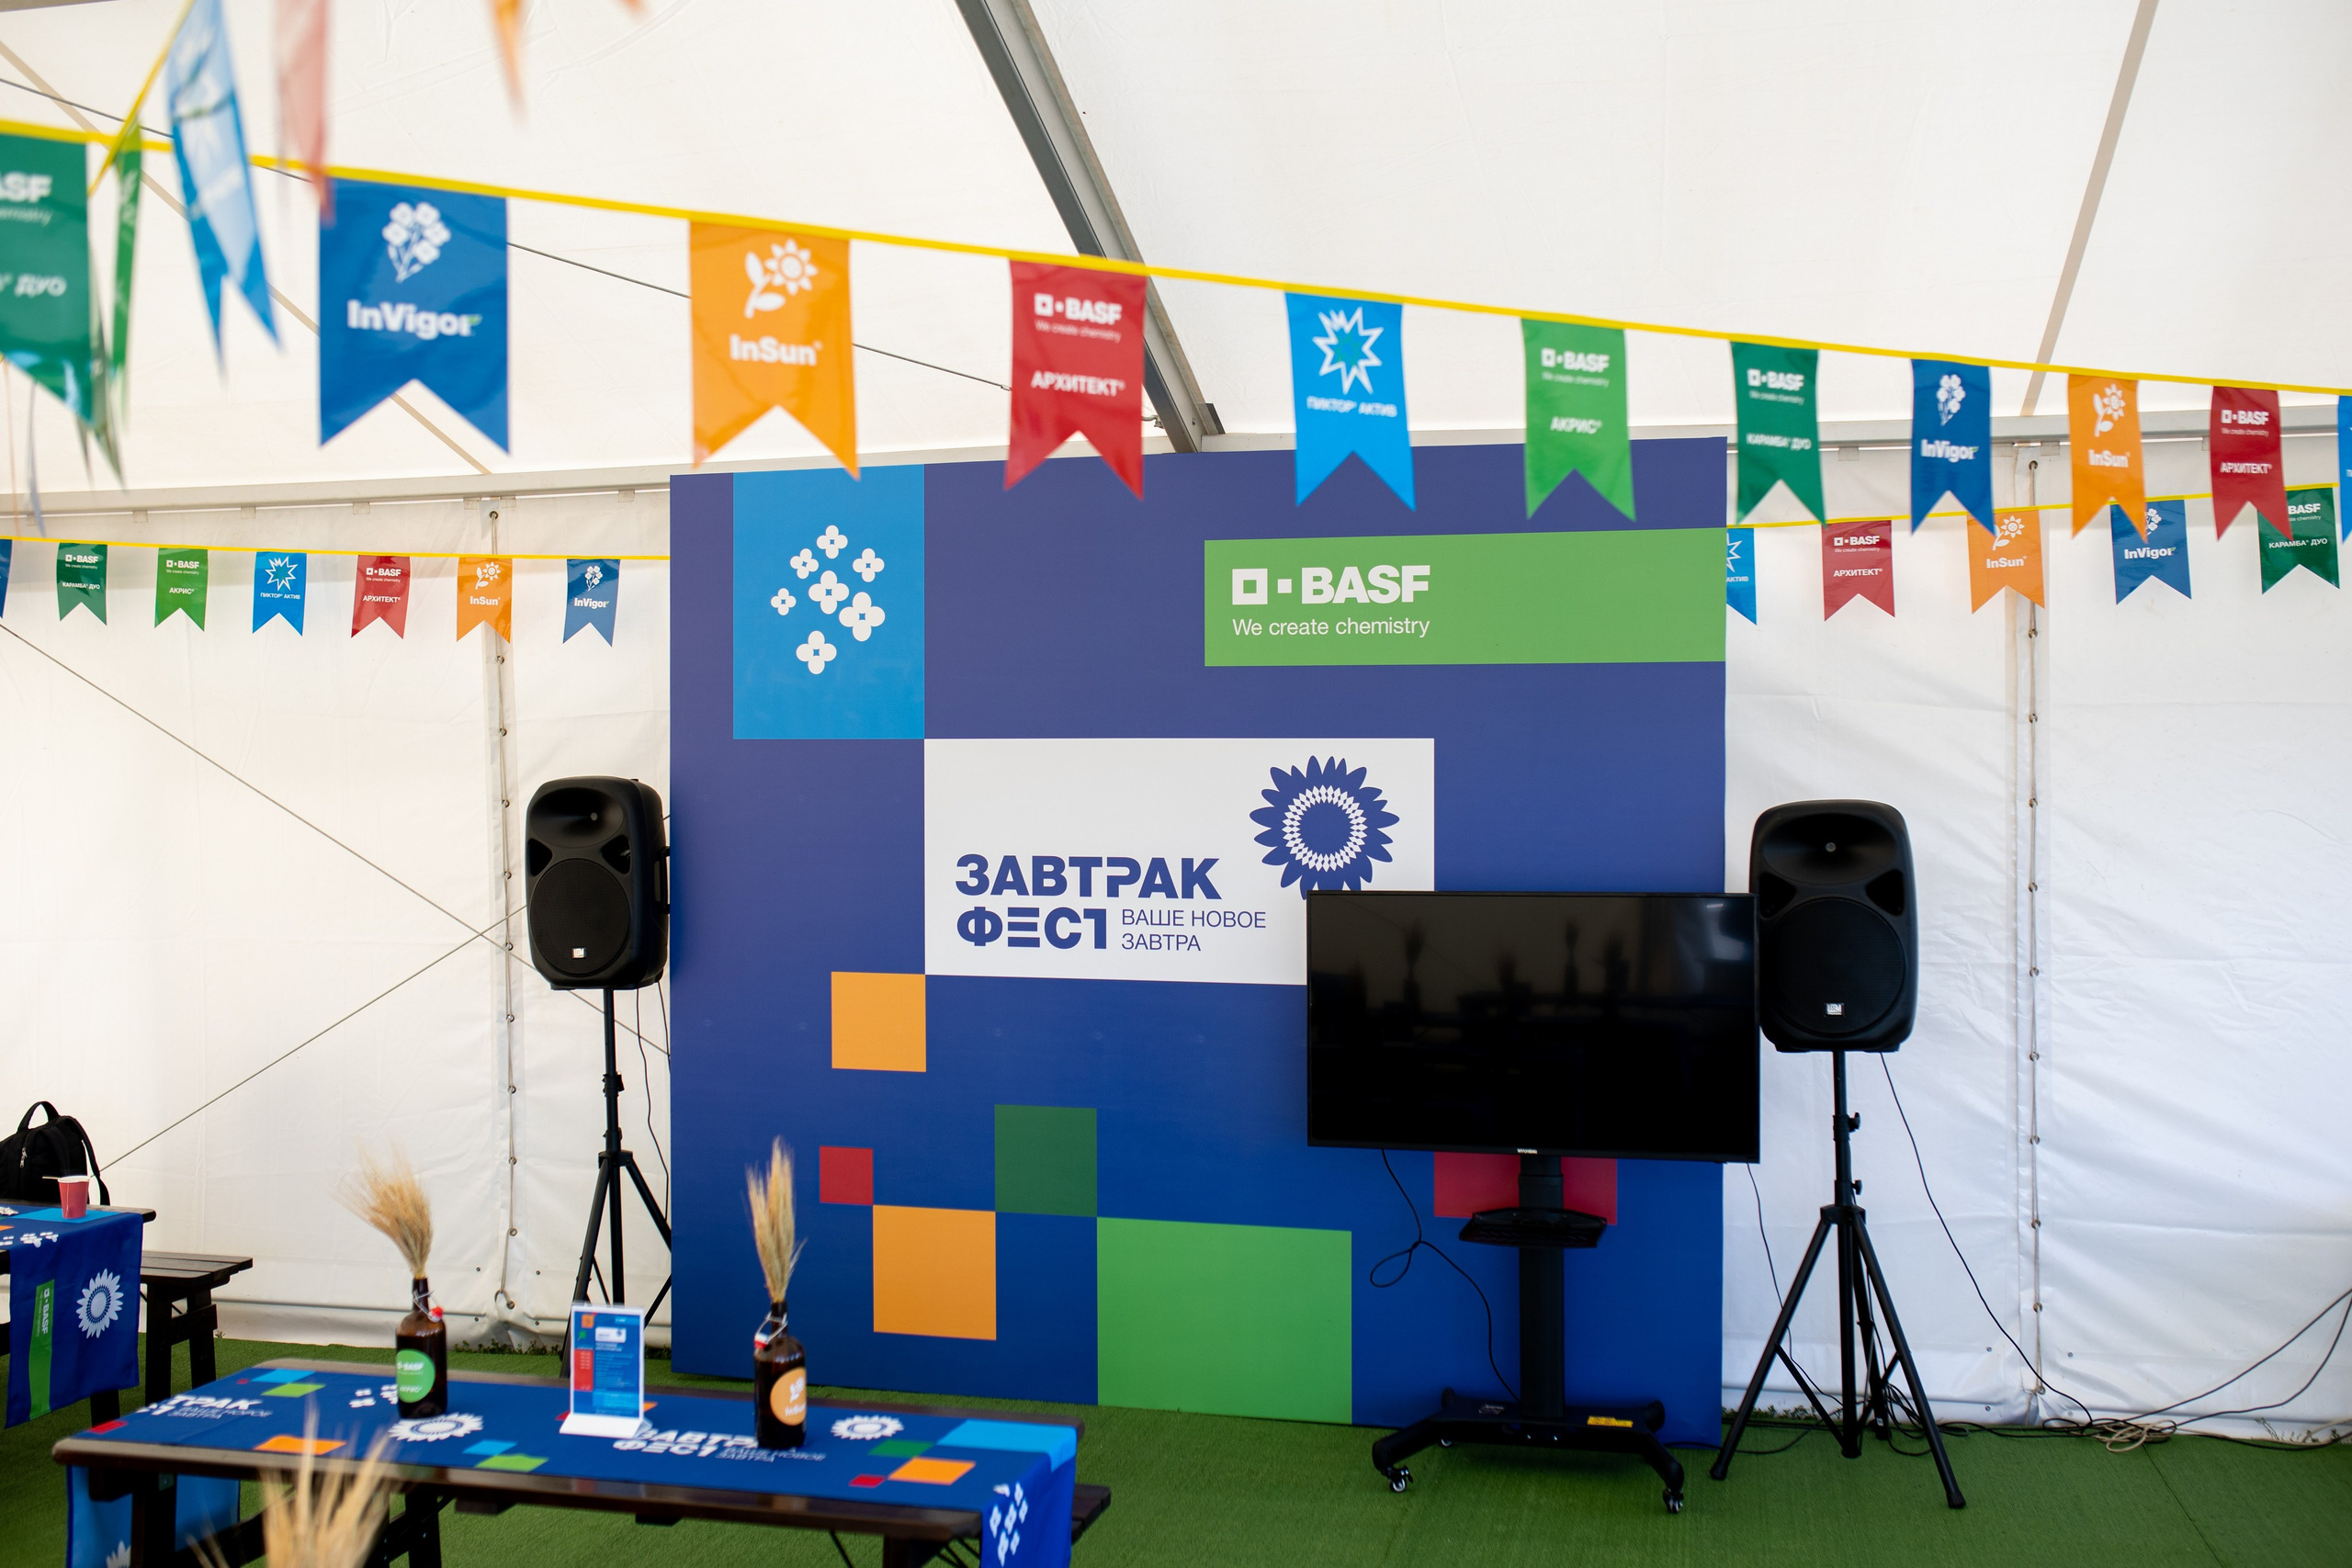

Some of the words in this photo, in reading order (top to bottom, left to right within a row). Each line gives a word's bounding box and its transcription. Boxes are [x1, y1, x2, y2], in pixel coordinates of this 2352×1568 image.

[0, 172, 52, 202] SF
[346, 299, 483, 341] InVigor
[1065, 296, 1123, 325] BASF
[1563, 350, 1610, 373] BASF
[1767, 371, 1804, 391] BASF
[2236, 410, 2269, 425] BASF
[1921, 439, 1979, 463] InVigor
[2288, 503, 2321, 514] BASF
[1849, 536, 1881, 546] BASF
[2311, 538, 2328, 547] ДУО
[76, 555, 98, 564] BASF
[2124, 547, 2177, 560] InVigor
[177, 560, 199, 570] BASF
[379, 568, 401, 577] BASF
[1301, 565, 1430, 604] BASF
[574, 597, 609, 609] InVigor
[1232, 618, 1262, 636] We
[1269, 618, 1329, 636] create
[1335, 616, 1430, 637] chemistry
[955, 853, 1223, 900] ЗАВТРАК
[956, 906, 1107, 950] ФЕСТ
[1122, 908, 1184, 927] ВАШЕ
[1192, 910, 1266, 929] НОВОЕ
[1121, 933, 1201, 952] ЗАВТРА
[166, 1394, 263, 1410] ТРАК
[640, 1428, 759, 1449] ЗАВТР
